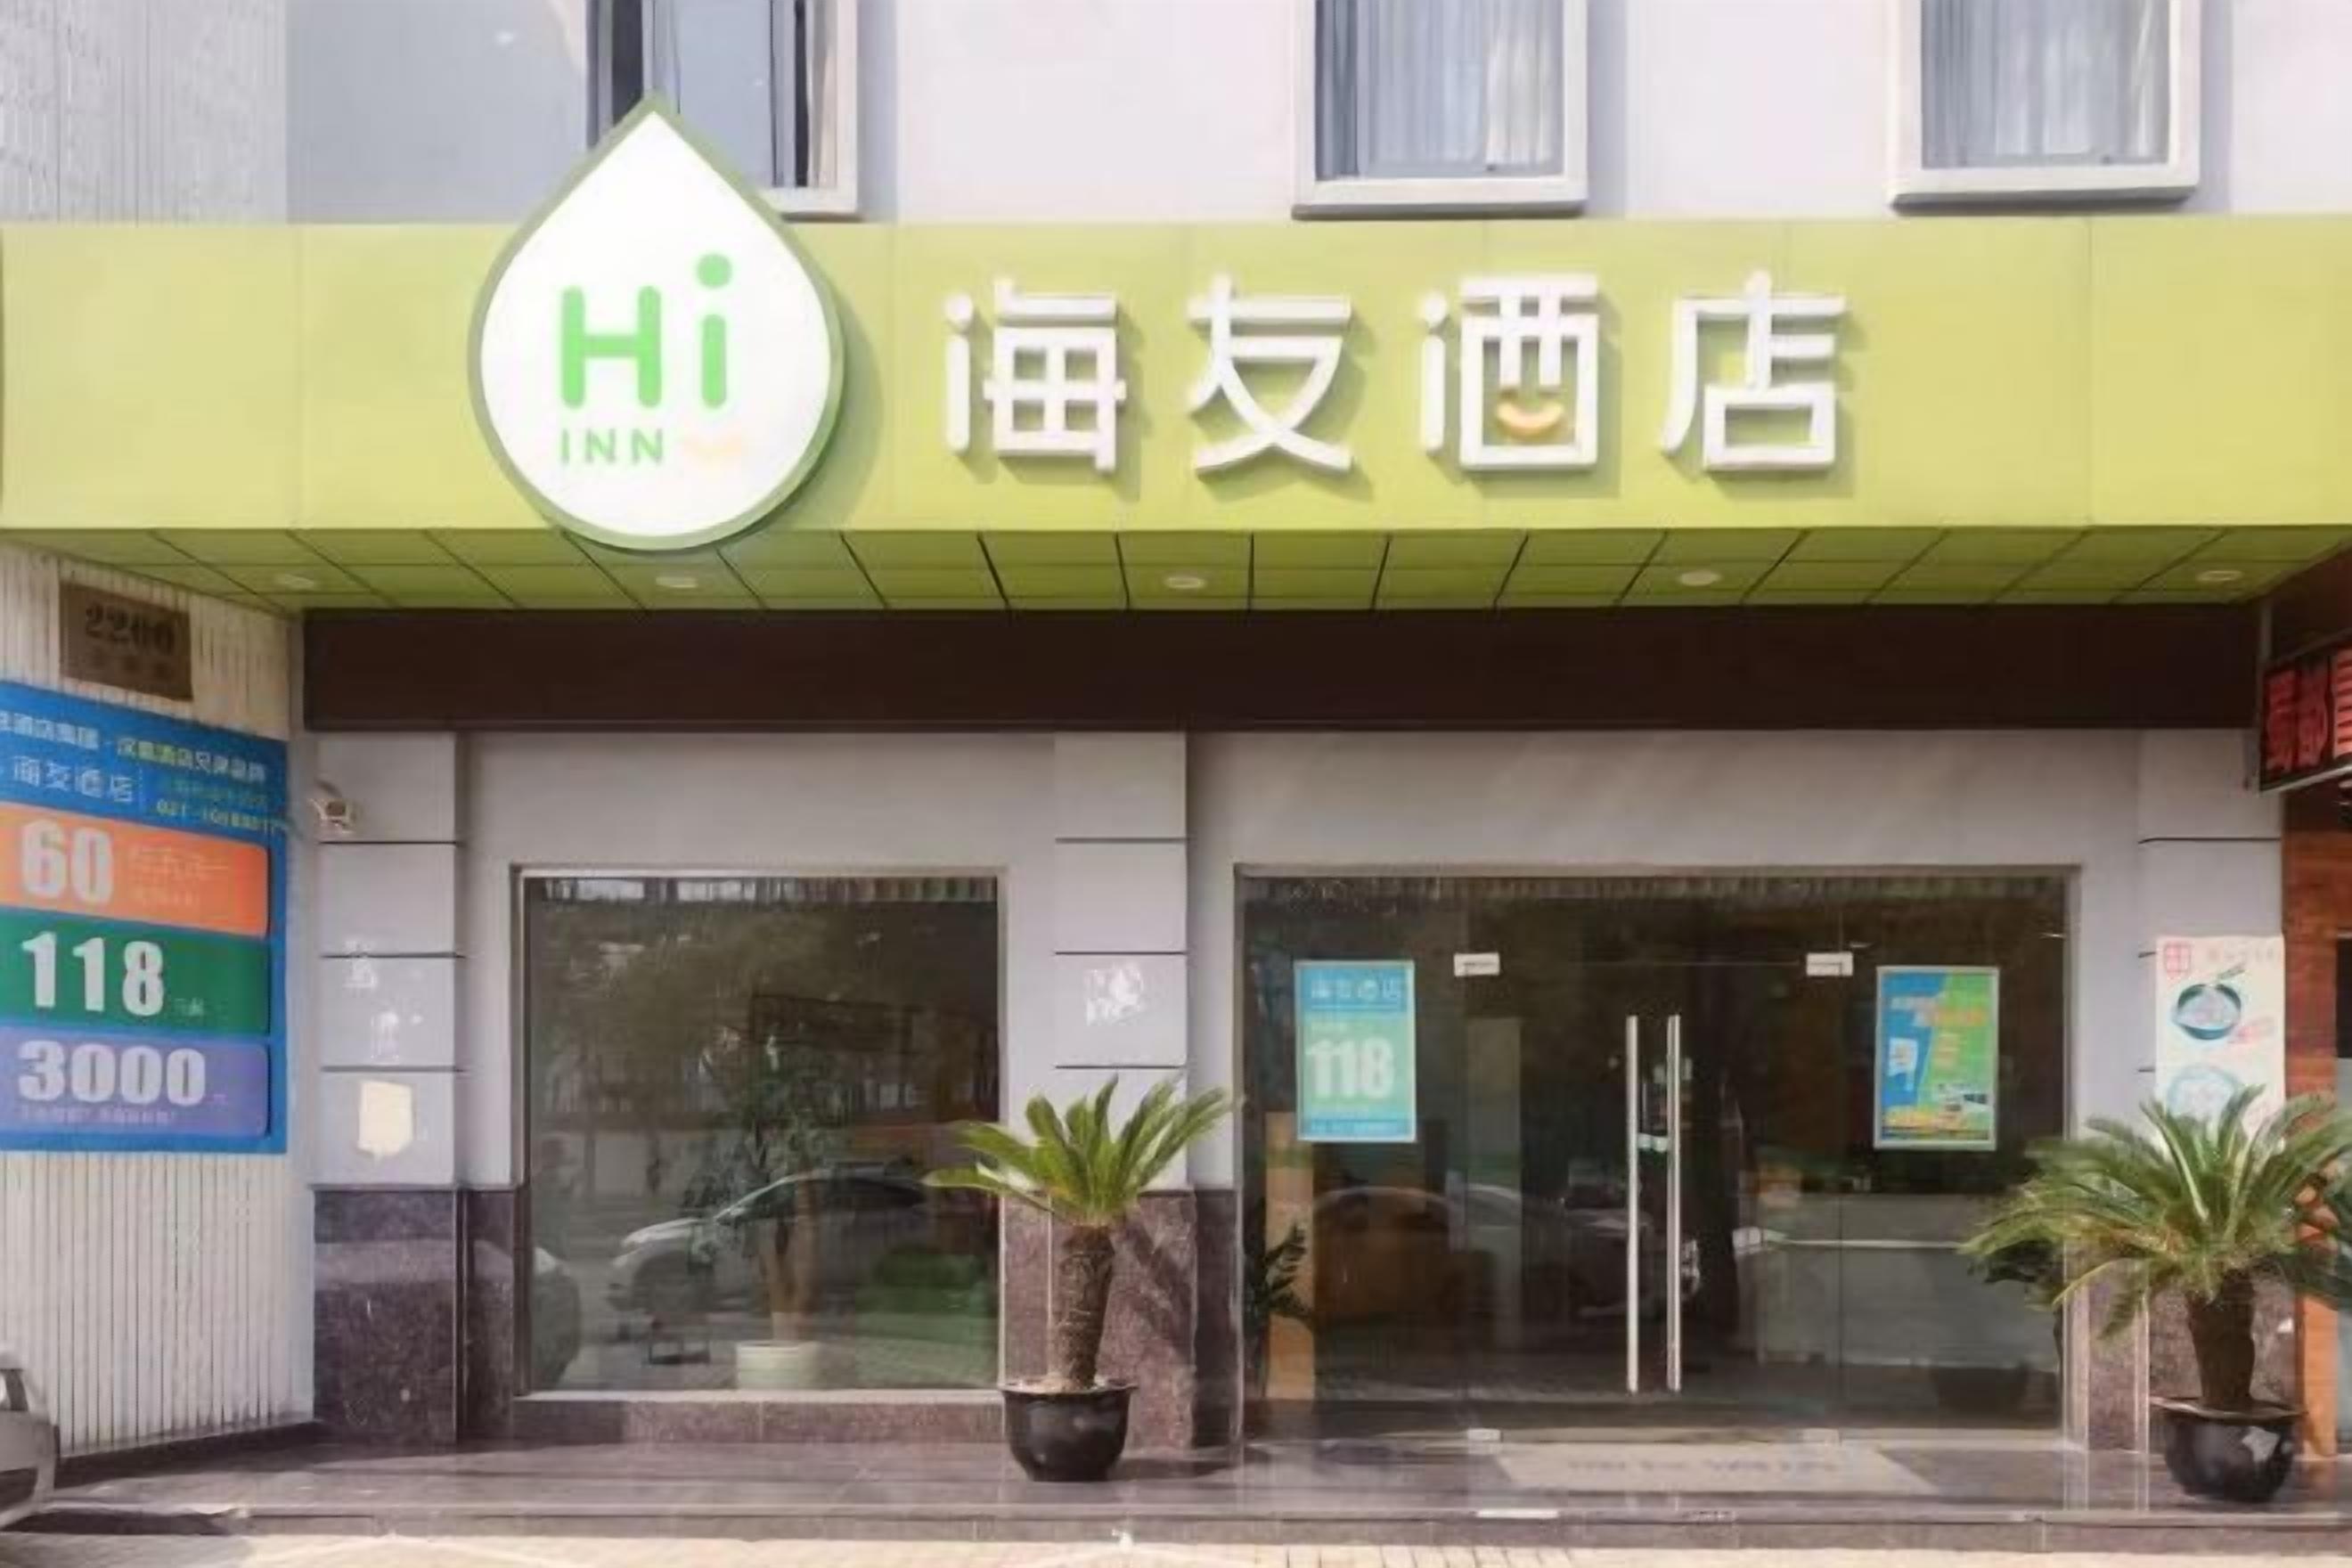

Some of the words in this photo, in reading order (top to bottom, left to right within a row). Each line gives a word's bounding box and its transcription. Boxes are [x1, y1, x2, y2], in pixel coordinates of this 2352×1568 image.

[559, 253, 733, 410] Hi
[943, 271, 1848, 473] 海友酒店
[559, 429, 665, 465] INN
[20, 819, 113, 906] 60
[21, 932, 165, 1017] 118
[18, 1040, 207, 1107] 3000
[1305, 1036, 1395, 1099] 118
